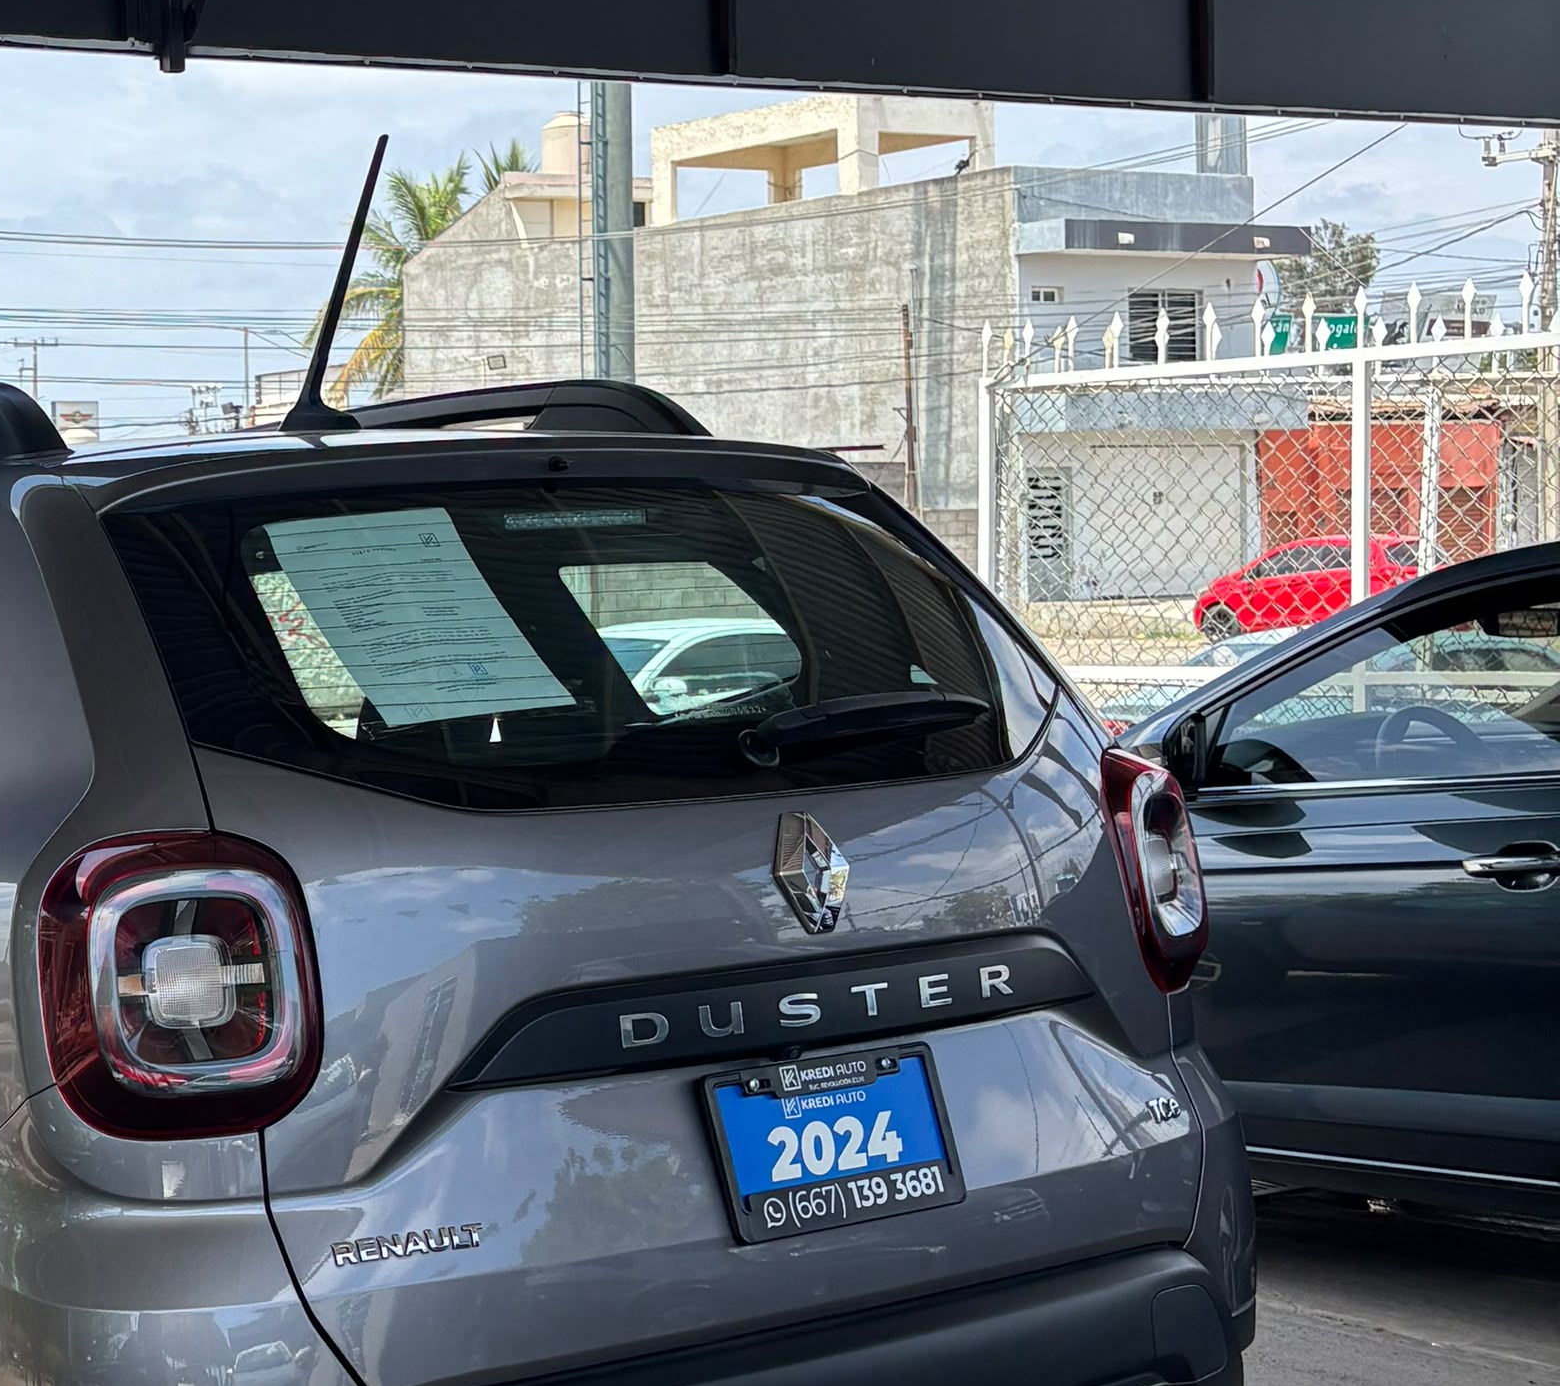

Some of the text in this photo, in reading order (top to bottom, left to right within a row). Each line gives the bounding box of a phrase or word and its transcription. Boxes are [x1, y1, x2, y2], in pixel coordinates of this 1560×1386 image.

[619, 964, 1014, 1049] DUSTER
[800, 1067, 835, 1081] KREDI
[835, 1060, 867, 1075] AUTO
[801, 1096, 835, 1110] KREDI
[836, 1090, 866, 1105] AUTO
[1145, 1097, 1181, 1124] TCe
[767, 1110, 903, 1183] 2024
[789, 1165, 945, 1228] (667) 139 3681
[331, 1222, 483, 1267] RENAULT
